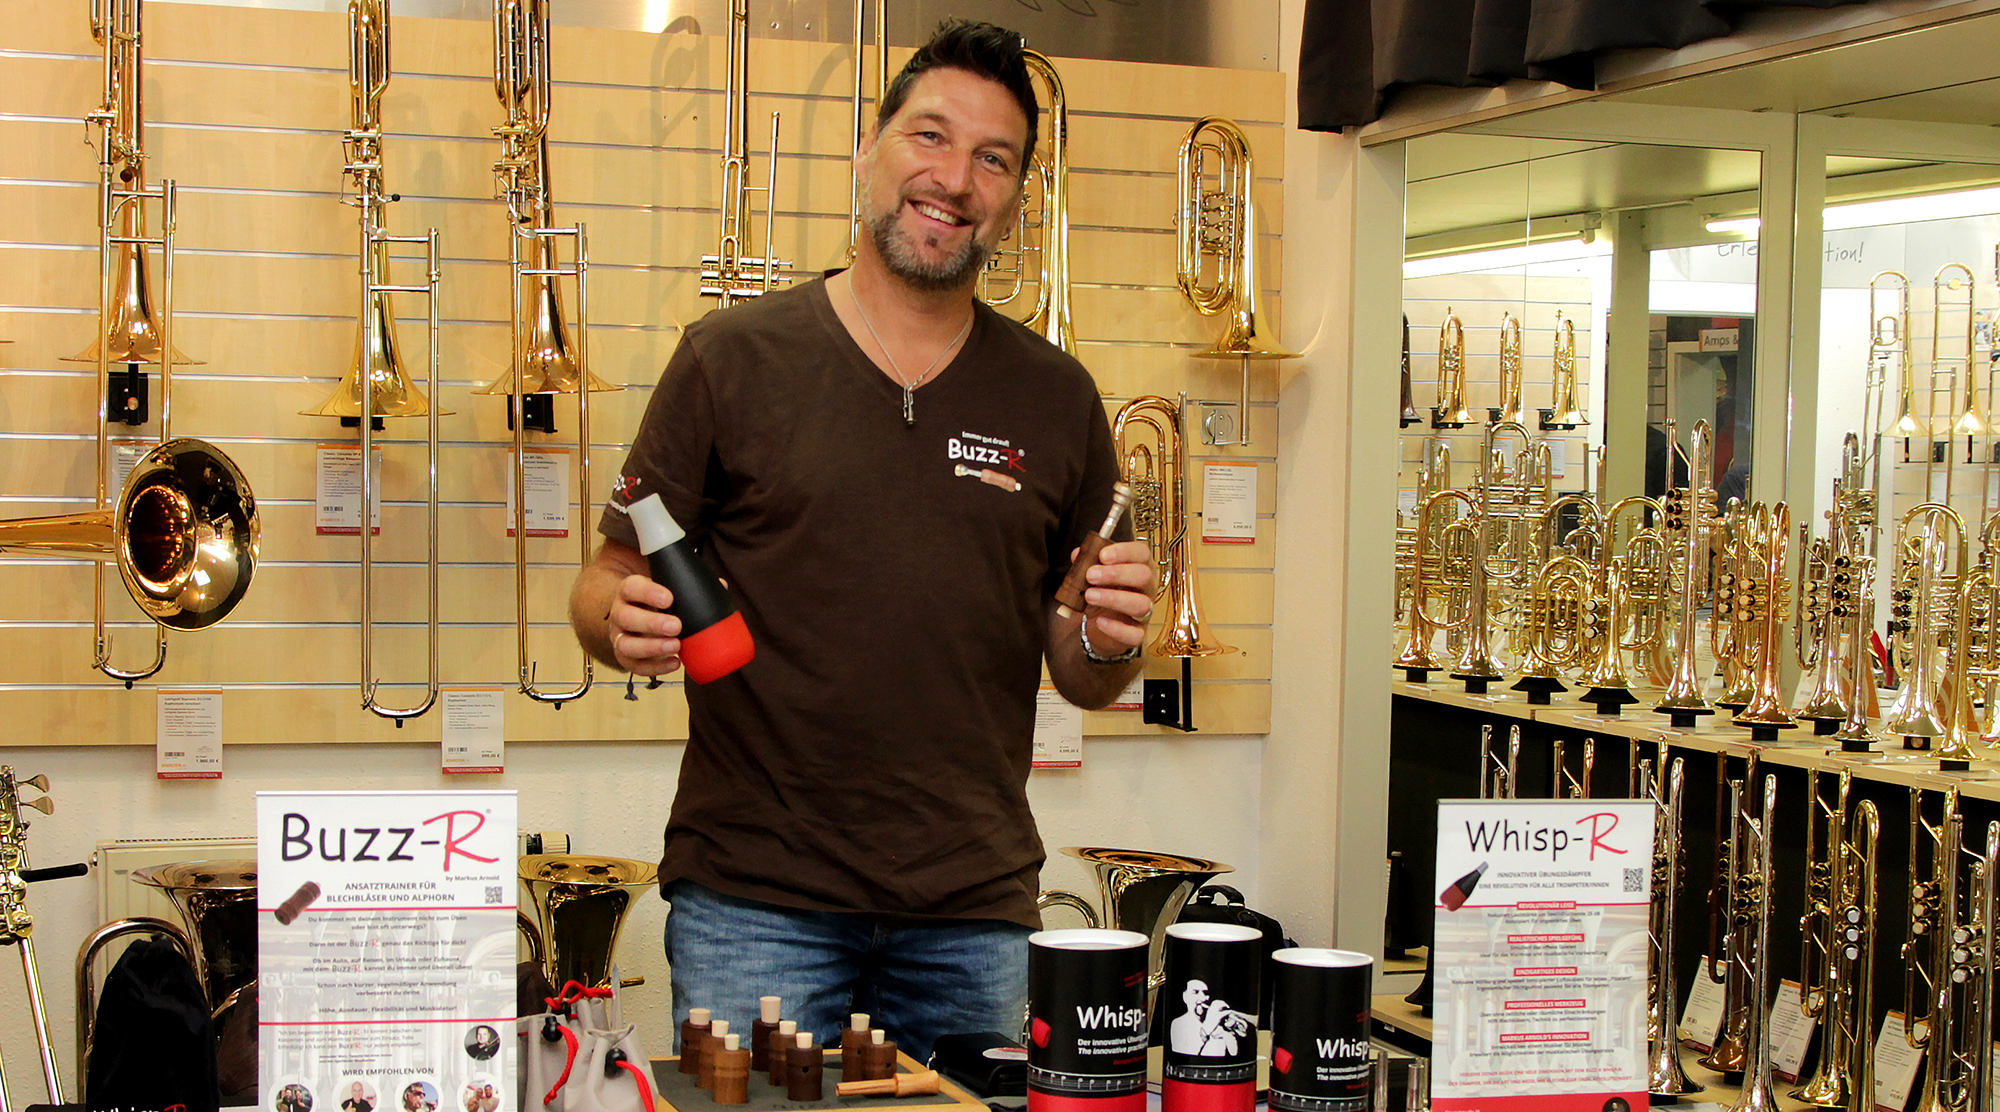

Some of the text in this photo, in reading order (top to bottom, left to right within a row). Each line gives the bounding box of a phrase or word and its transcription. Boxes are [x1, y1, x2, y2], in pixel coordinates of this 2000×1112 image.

[1704, 335, 1730, 347] Amps
[282, 810, 499, 872] Buzz-R
[1466, 813, 1628, 862] Whisp-R
[420, 881, 436, 890] FÜR
[326, 894, 387, 902] BLECHBLÄSER
[1077, 1004, 1147, 1031] Whisp-
[1078, 1047, 1092, 1055] The
[366, 1068, 414, 1076] EMPFOHLEN
